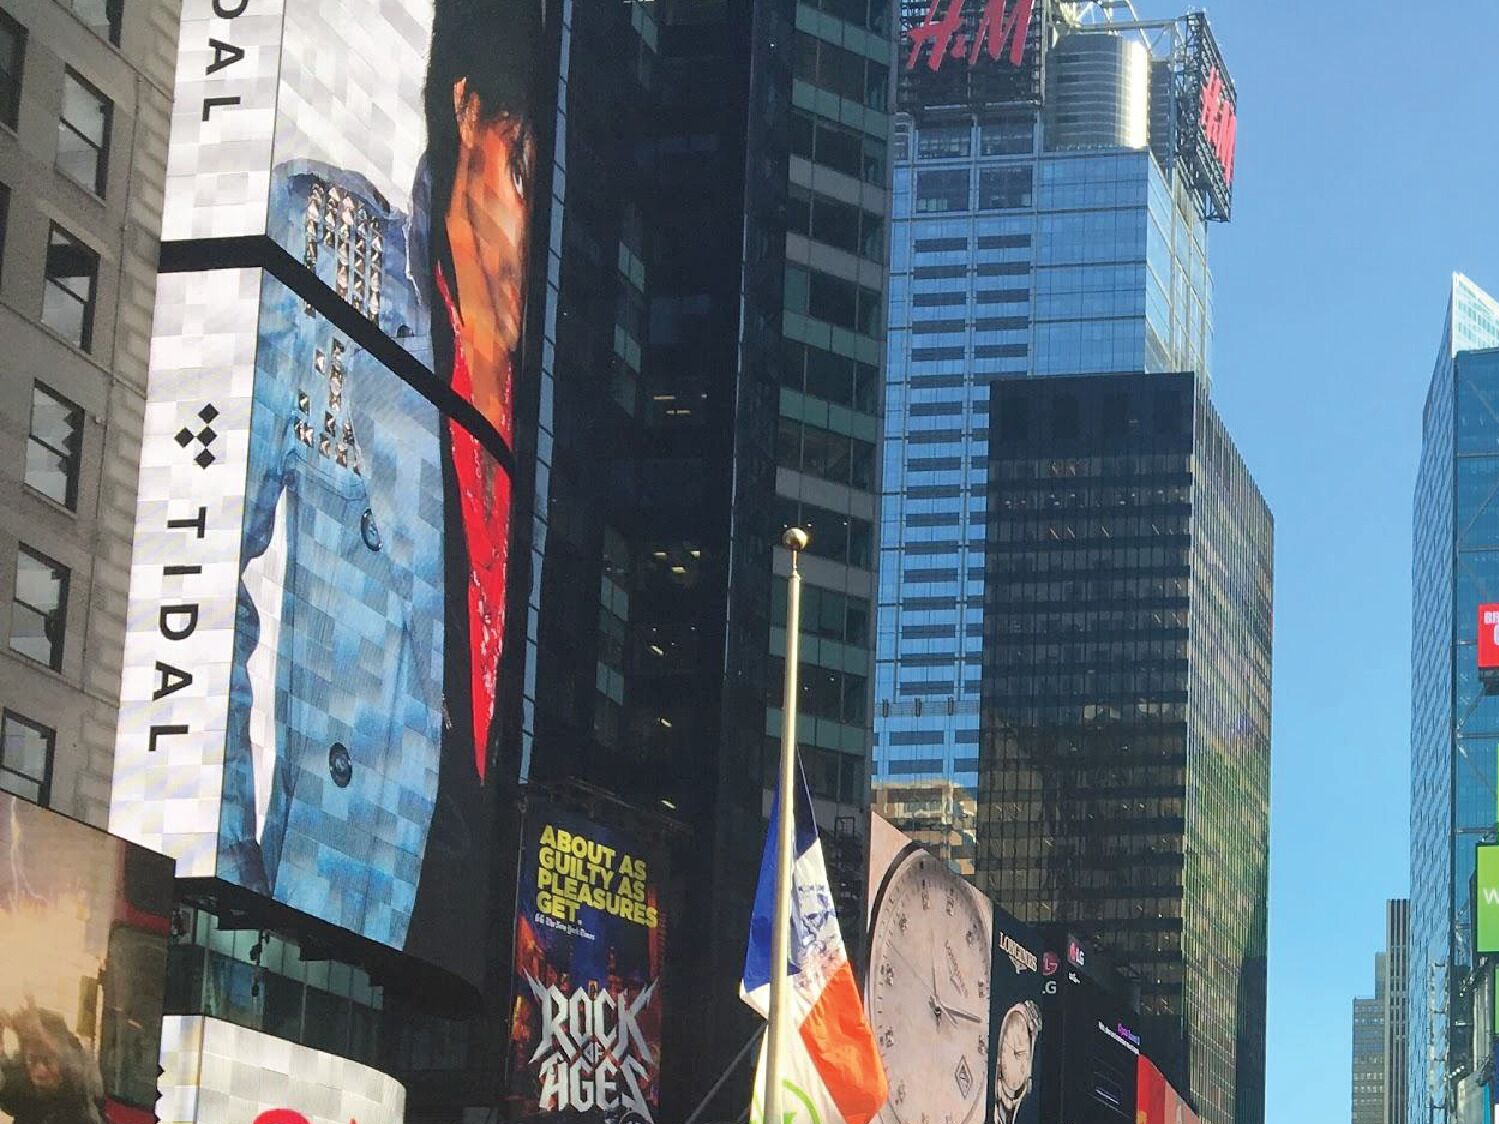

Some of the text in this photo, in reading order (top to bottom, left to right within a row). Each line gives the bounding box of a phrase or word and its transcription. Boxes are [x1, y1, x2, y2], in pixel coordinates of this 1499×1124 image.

[149, 506, 207, 753] TIDAL
[538, 846, 645, 902] GUILTY AS
[540, 824, 648, 881] ABOUT AS
[537, 866, 658, 929] PLEASURES
[524, 970, 659, 1065] ROCK
